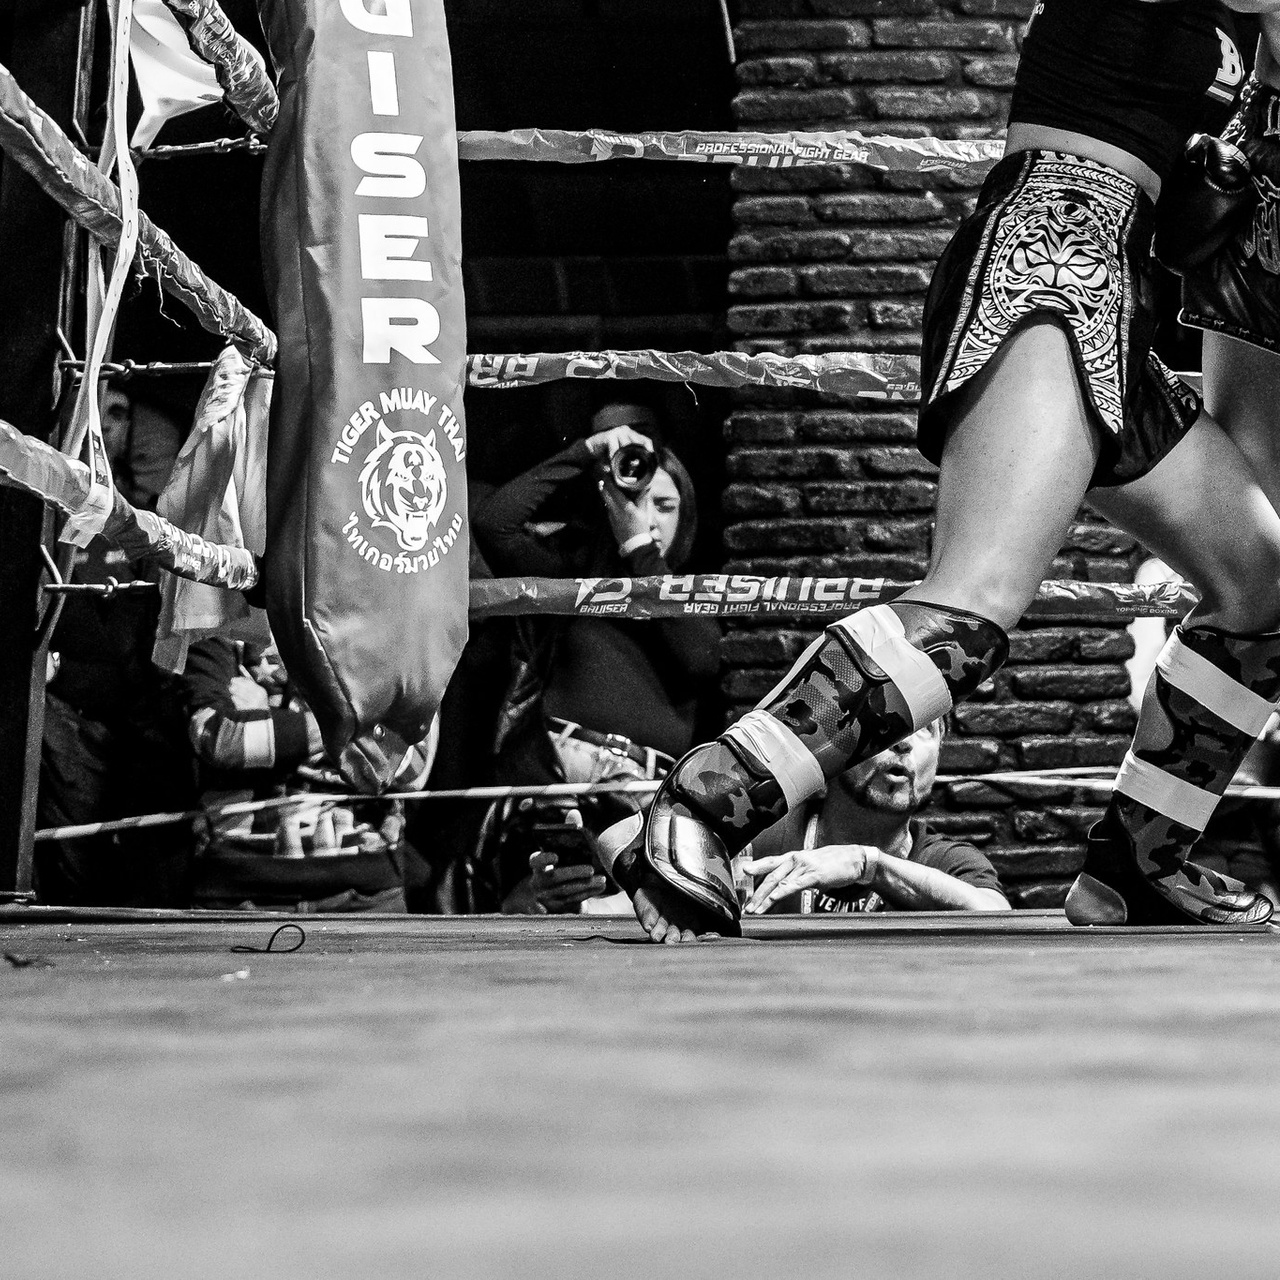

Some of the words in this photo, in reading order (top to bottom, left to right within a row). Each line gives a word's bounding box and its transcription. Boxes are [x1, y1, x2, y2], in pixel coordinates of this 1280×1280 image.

[695, 141, 795, 156] PROFESSIONAL
[832, 149, 870, 163] GEAR
[331, 401, 381, 464] TIGER
[379, 387, 438, 416] MUAY
[437, 404, 466, 463] THAI
[580, 602, 628, 614] BRUISER
[684, 602, 719, 614] GEAR
[723, 602, 760, 615] FIGHT
[763, 600, 861, 614] PROFESSIONAL
